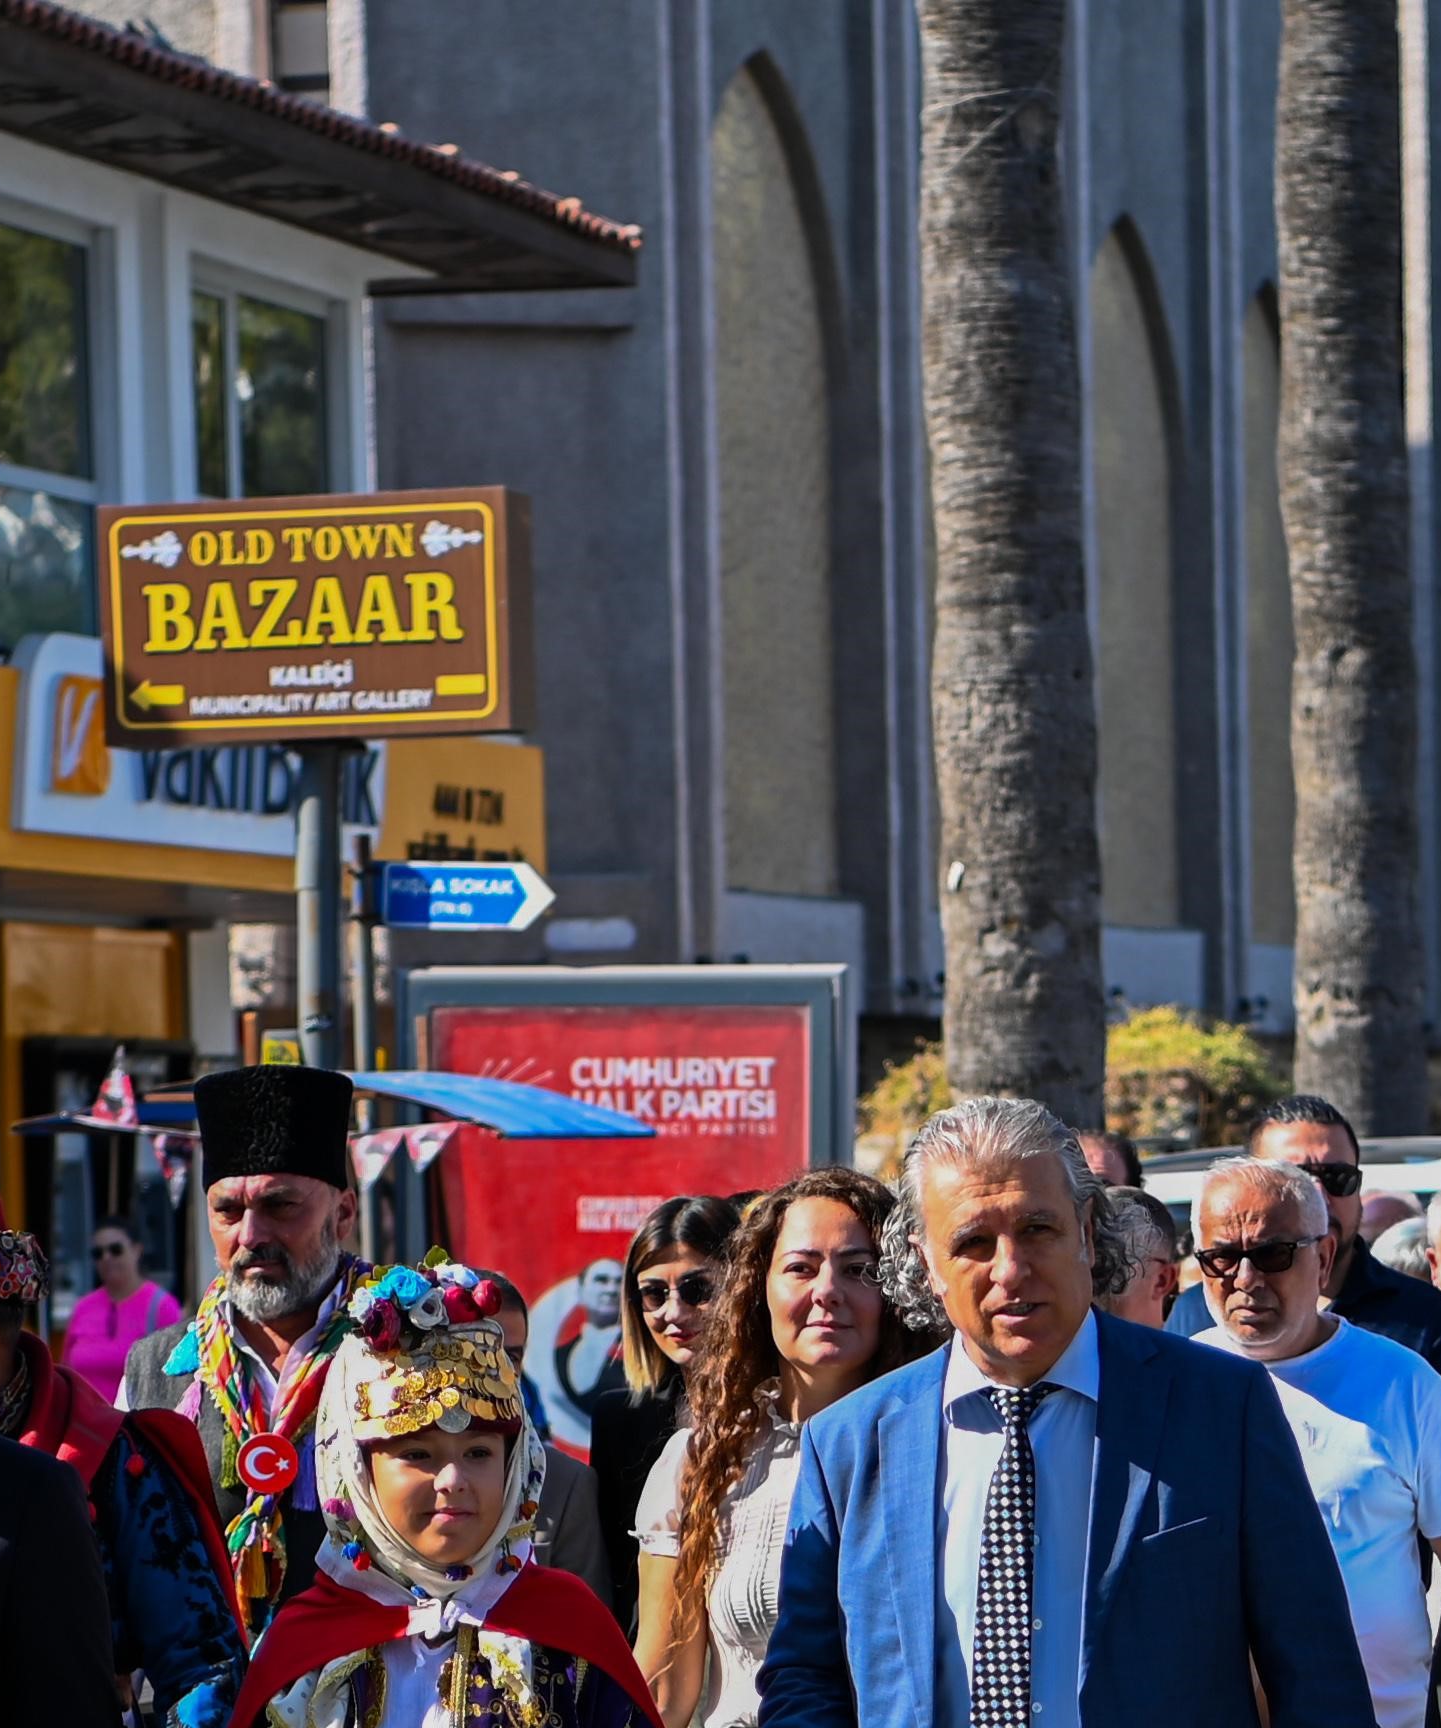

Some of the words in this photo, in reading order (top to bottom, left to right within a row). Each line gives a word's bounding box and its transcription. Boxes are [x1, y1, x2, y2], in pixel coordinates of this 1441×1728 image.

[188, 529, 275, 566] OLD
[282, 522, 415, 564] TOWN
[141, 571, 464, 653] BAZAAR
[189, 693, 312, 717] MUNICIPALITY
[314, 692, 350, 712] ART
[351, 688, 434, 711] GALLERY
[450, 878, 514, 895] SOKAK
